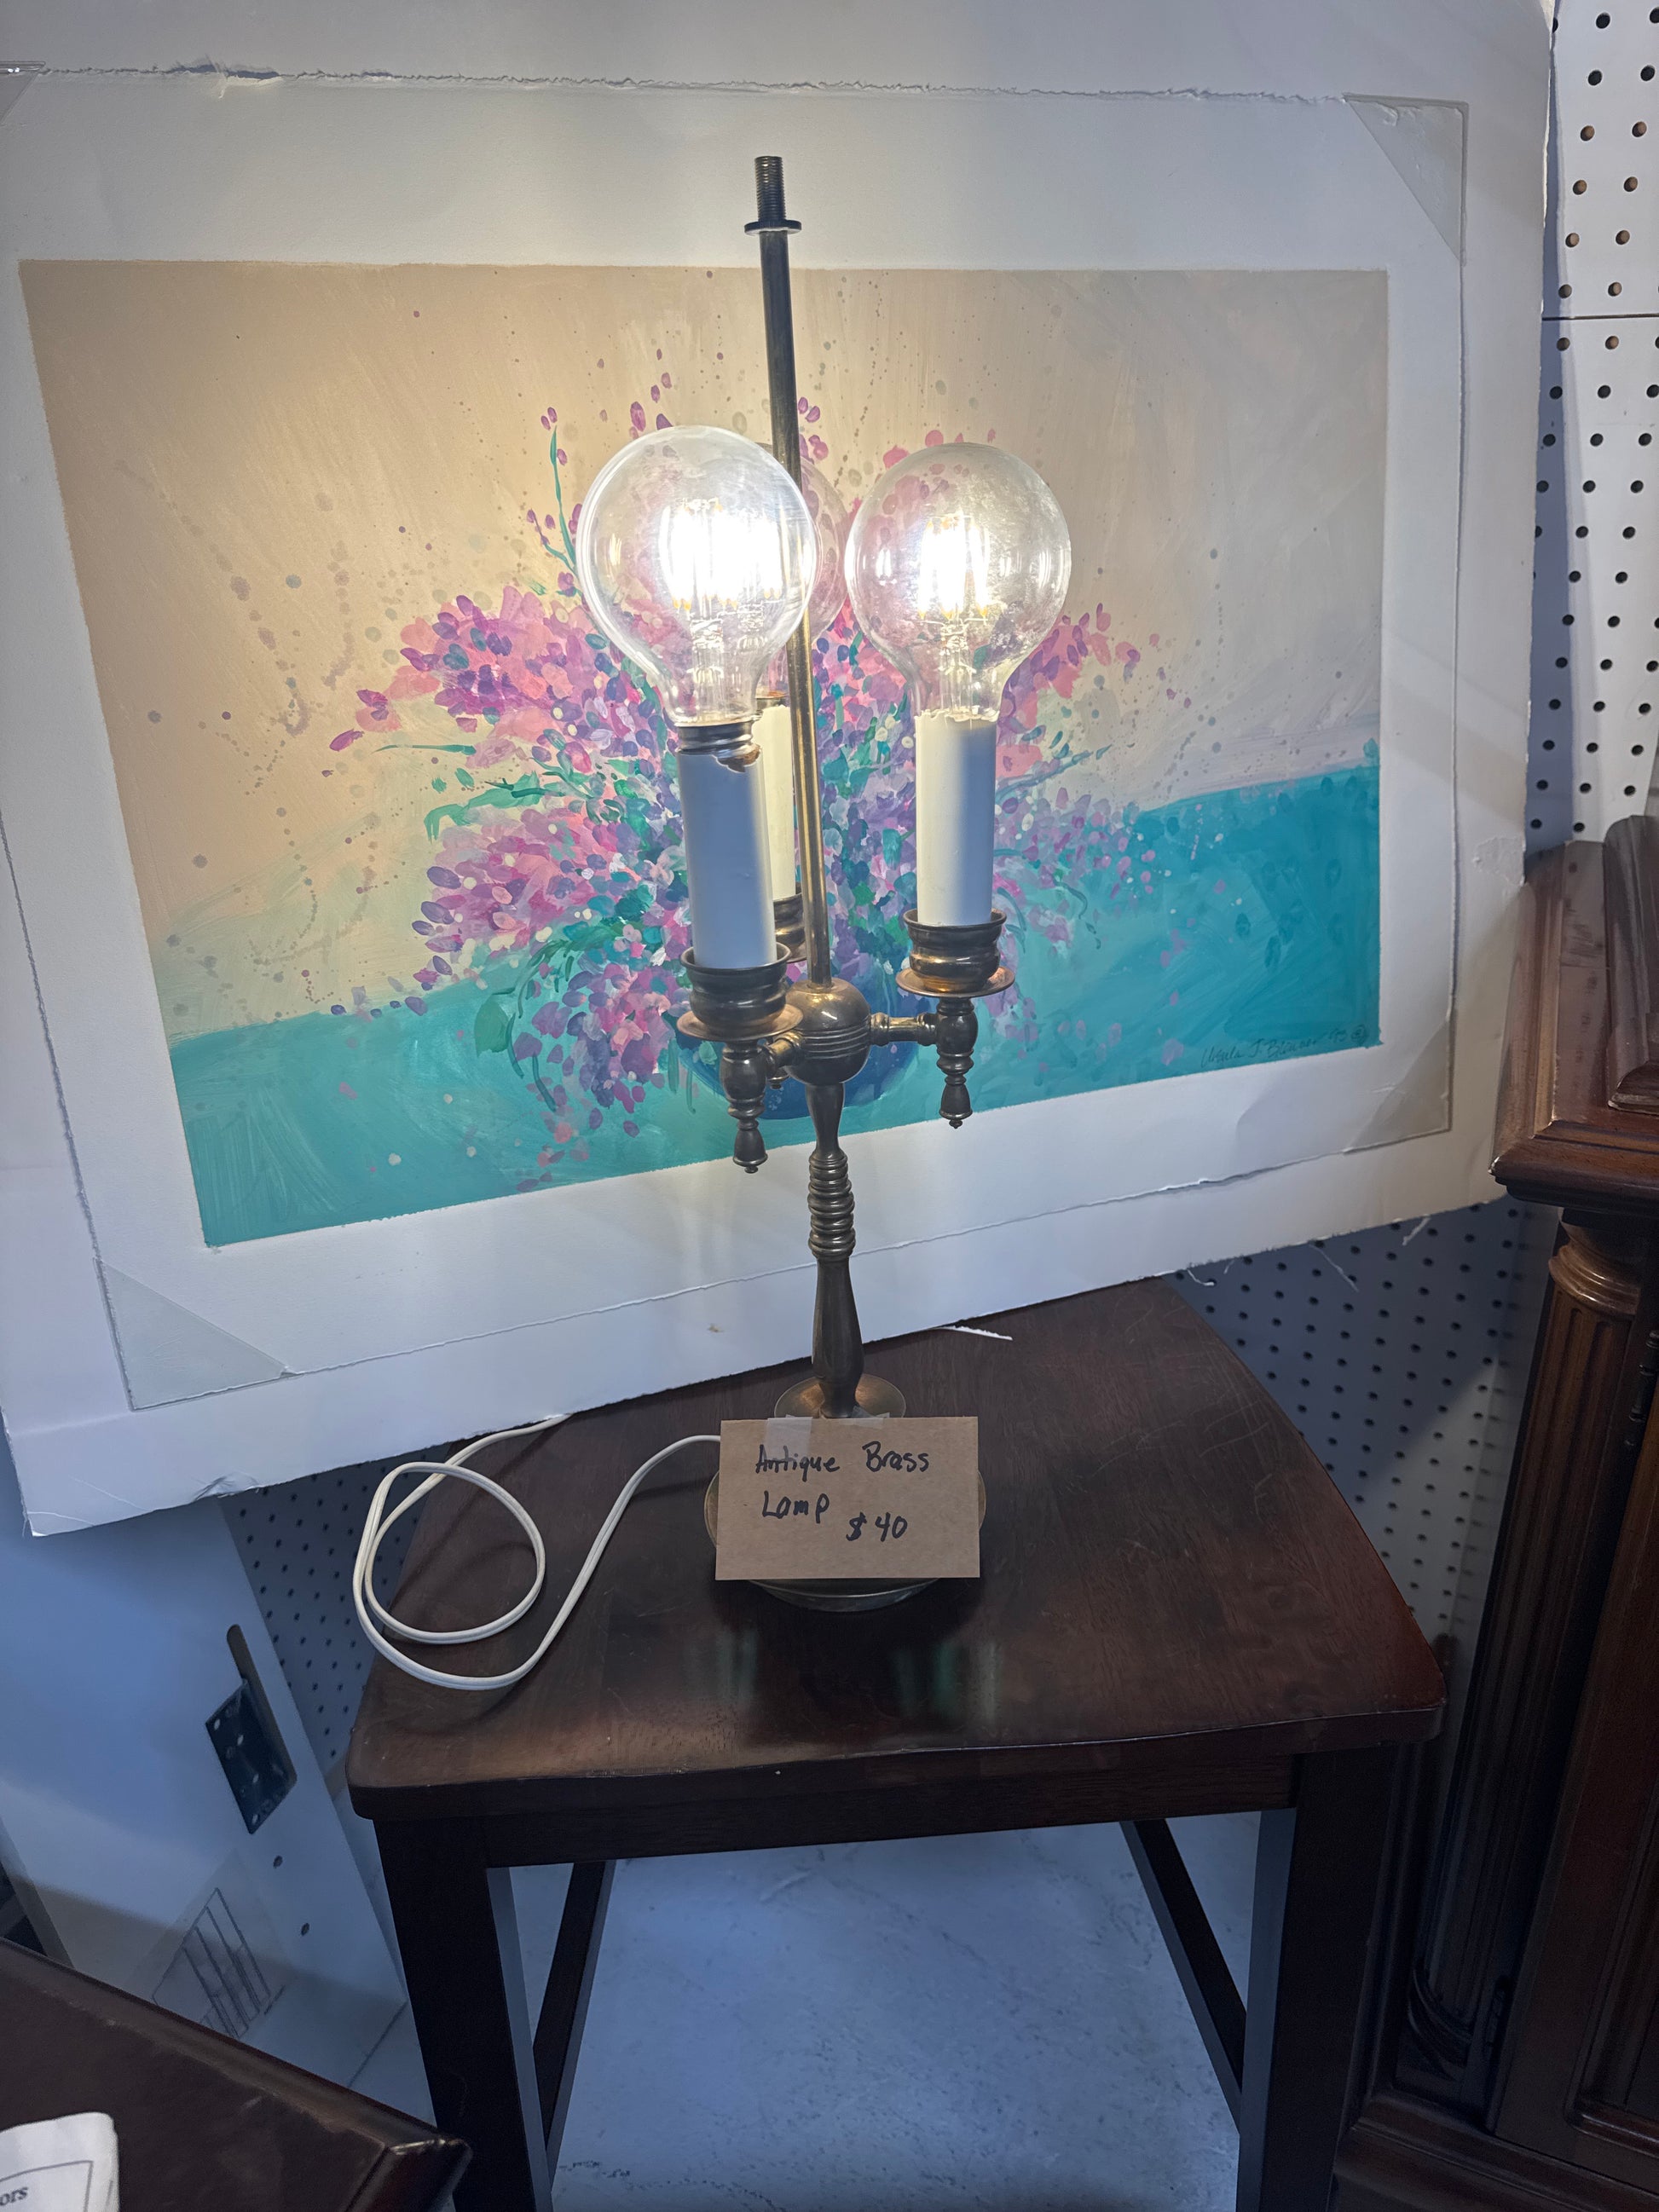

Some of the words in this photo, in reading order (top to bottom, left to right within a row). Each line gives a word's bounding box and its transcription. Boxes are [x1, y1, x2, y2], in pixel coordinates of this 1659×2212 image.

[755, 1444, 840, 1481] Antique
[862, 1441, 929, 1471] Brass
[761, 1490, 830, 1523] Lamp
[846, 1511, 908, 1542] $40
